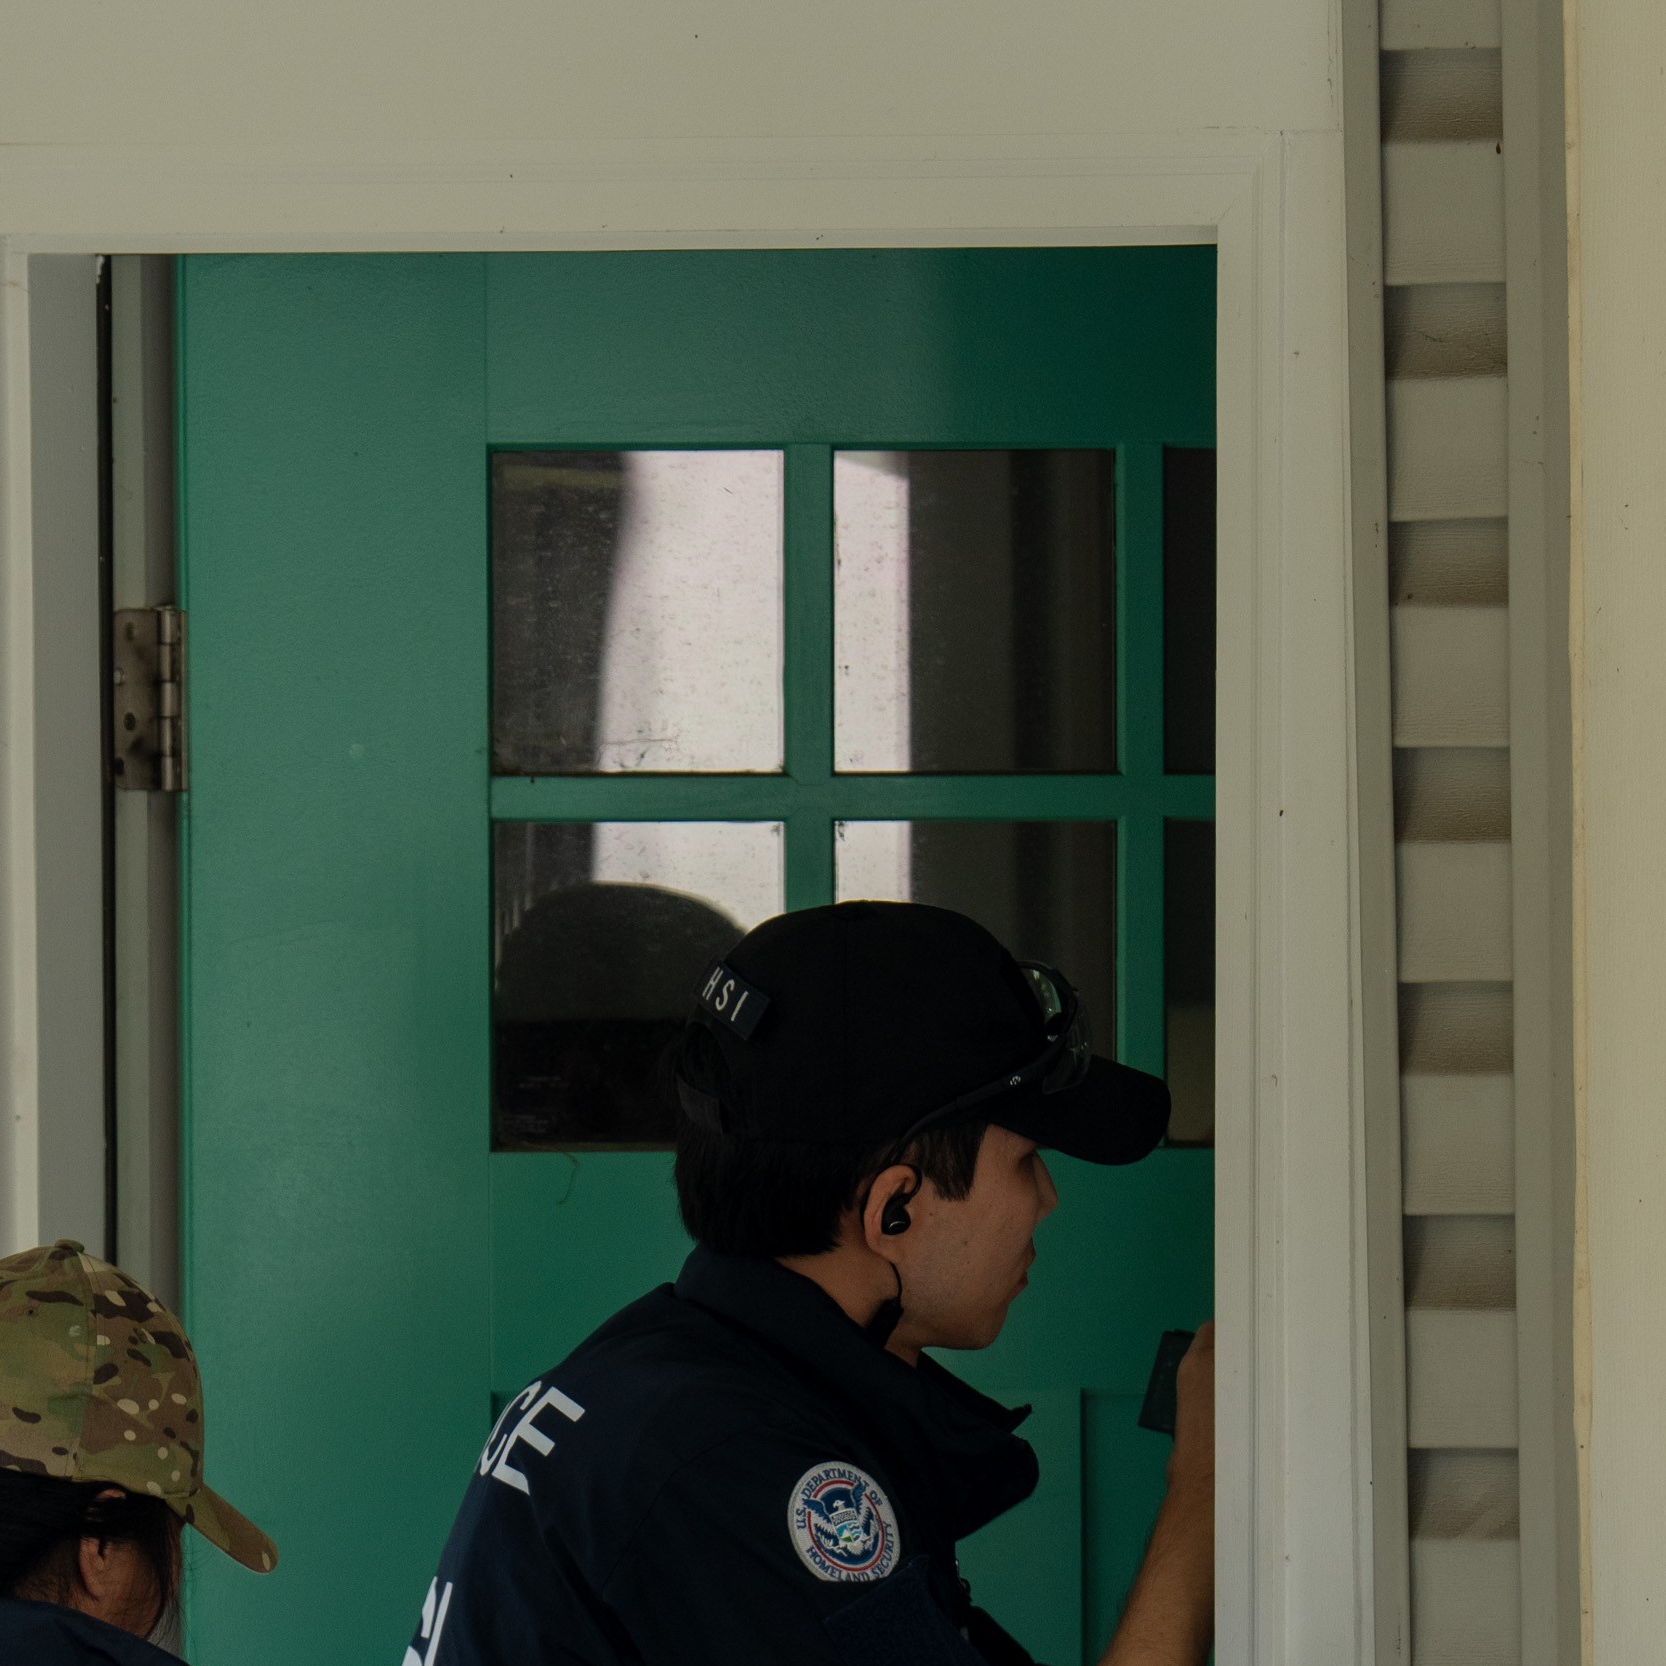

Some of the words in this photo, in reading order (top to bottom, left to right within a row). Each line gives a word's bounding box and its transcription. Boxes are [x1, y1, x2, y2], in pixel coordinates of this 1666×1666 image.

[702, 966, 748, 1021] HSI
[801, 1468, 870, 1499] DEPARTMENT
[869, 1490, 883, 1506] OF
[871, 1522, 893, 1578] SECURITY
